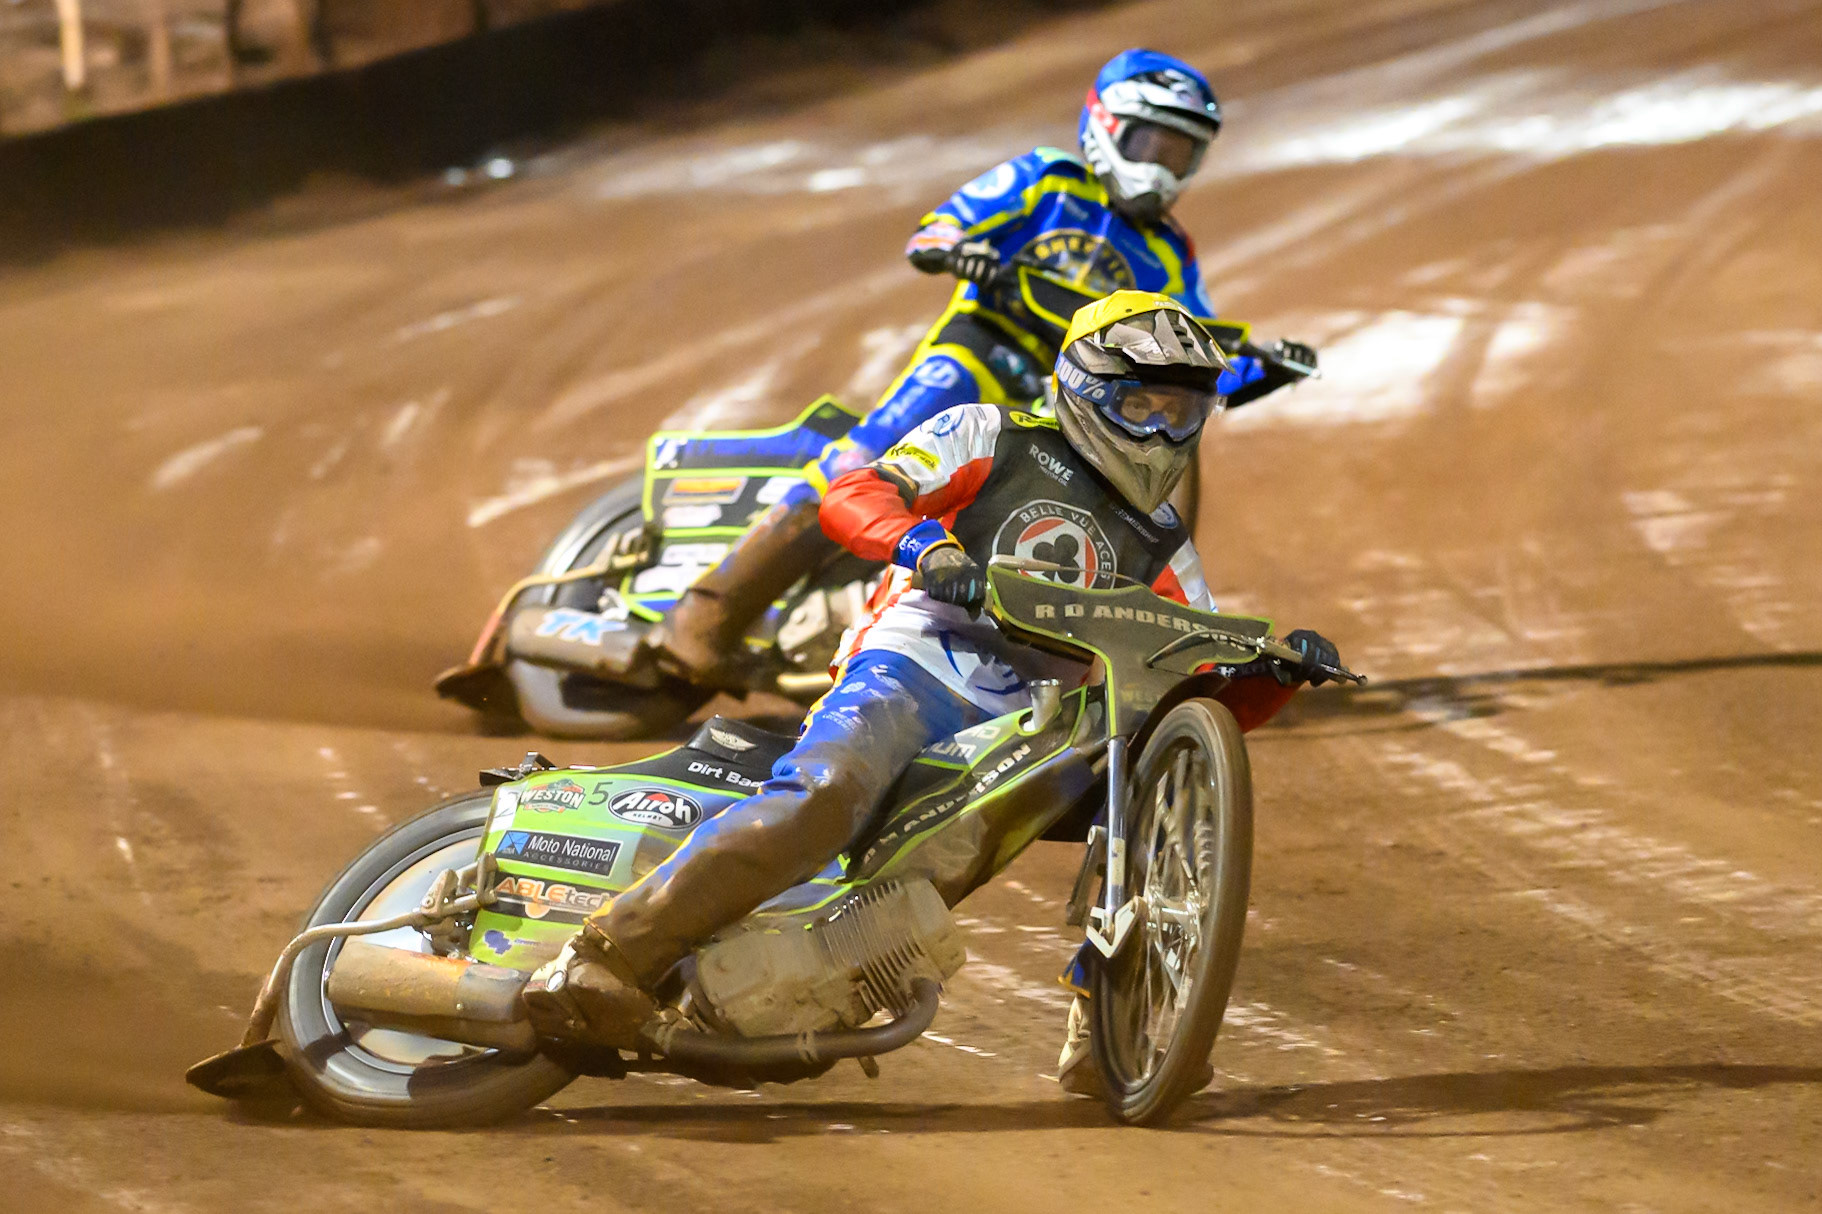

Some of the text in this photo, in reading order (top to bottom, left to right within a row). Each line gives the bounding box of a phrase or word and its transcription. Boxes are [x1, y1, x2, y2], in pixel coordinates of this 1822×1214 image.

[1056, 354, 1106, 400] 100%
[1029, 443, 1074, 482] ROWE
[1019, 506, 1111, 580] BELLE VUE ACES
[1035, 604, 1055, 619] R
[1064, 603, 1084, 618] D
[687, 761, 723, 779] Dirt
[520, 789, 585, 809] WESTON
[588, 781, 613, 806] 5
[612, 791, 692, 824] Airoh
[527, 834, 617, 863] Moto National
